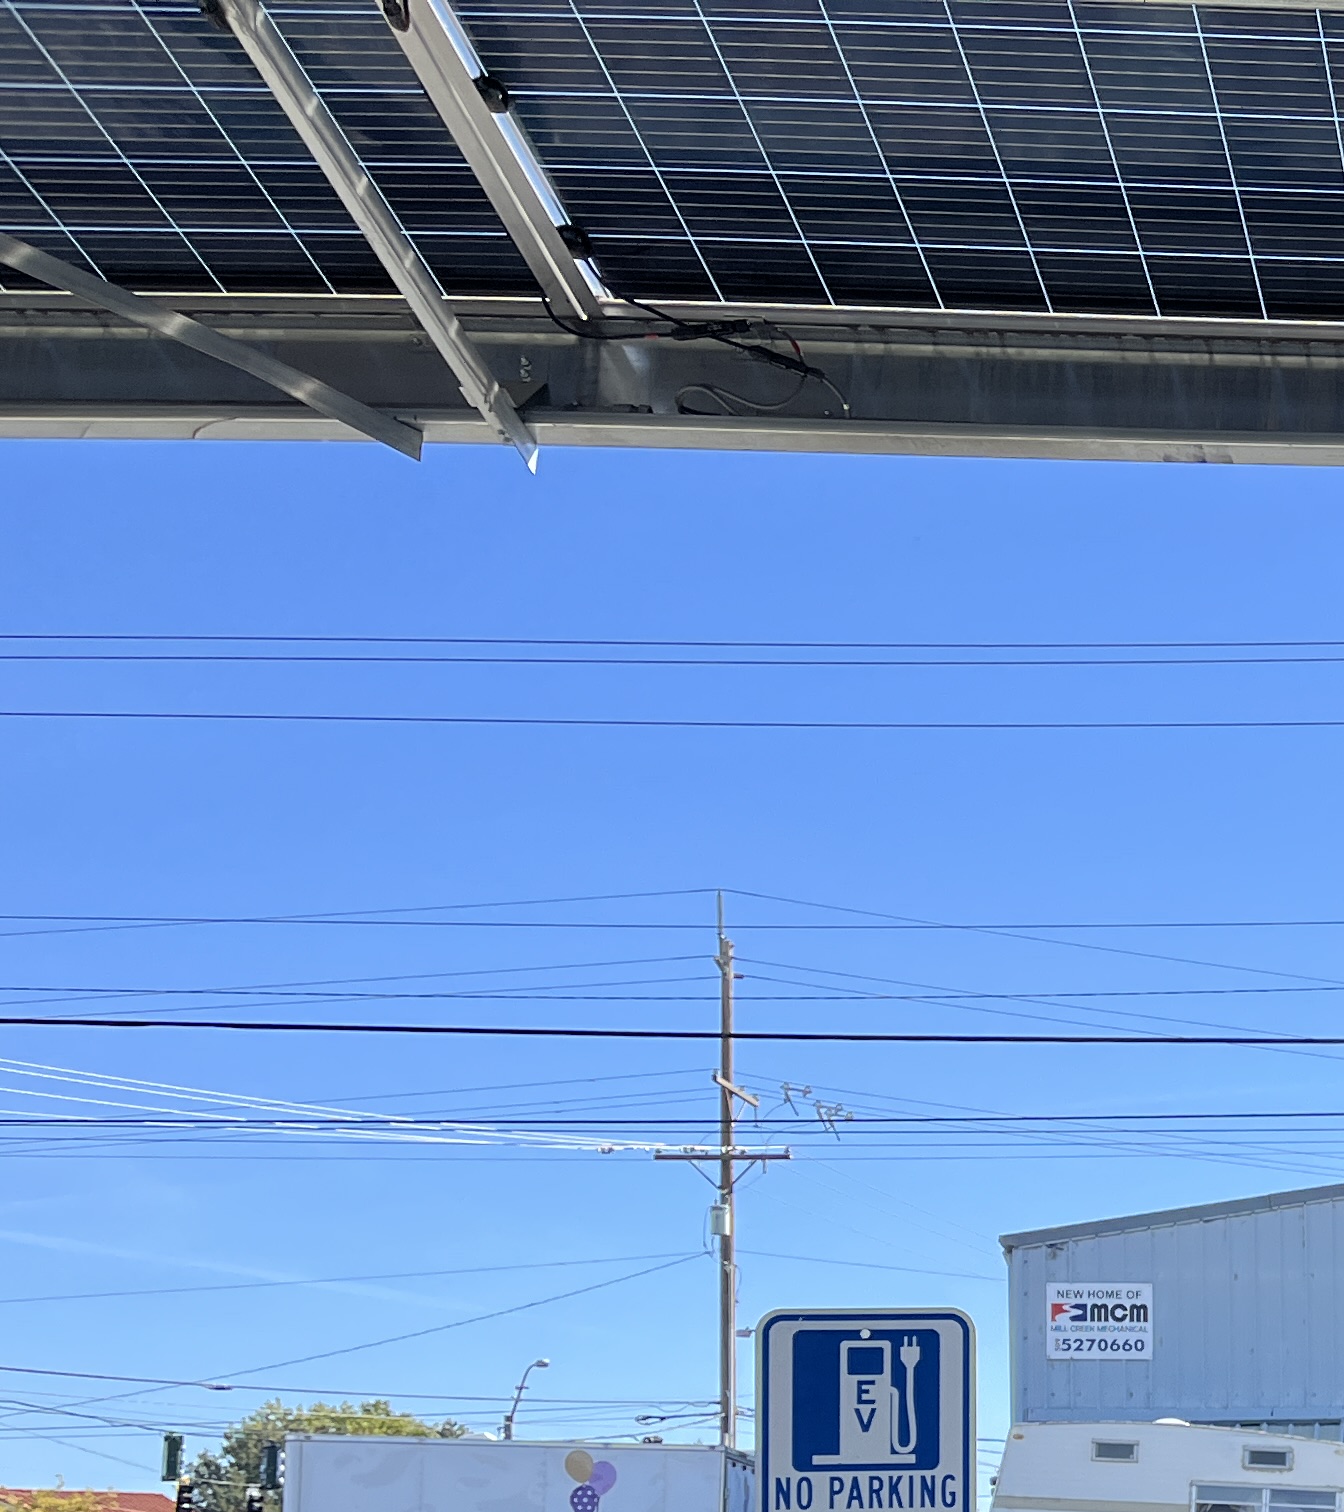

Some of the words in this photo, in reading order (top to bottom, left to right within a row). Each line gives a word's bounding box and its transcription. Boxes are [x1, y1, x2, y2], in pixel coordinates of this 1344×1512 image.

[1056, 1289, 1084, 1299] NEW
[1087, 1289, 1122, 1299] HOME
[1126, 1289, 1142, 1299] OF
[1050, 1325, 1068, 1333] MILL
[1070, 1325, 1095, 1333] CREEK
[1097, 1325, 1148, 1333] MECHANICAL
[1061, 1338, 1145, 1352] 5270660
[775, 1476, 813, 1511] NO
[828, 1474, 957, 1509] PARKING
